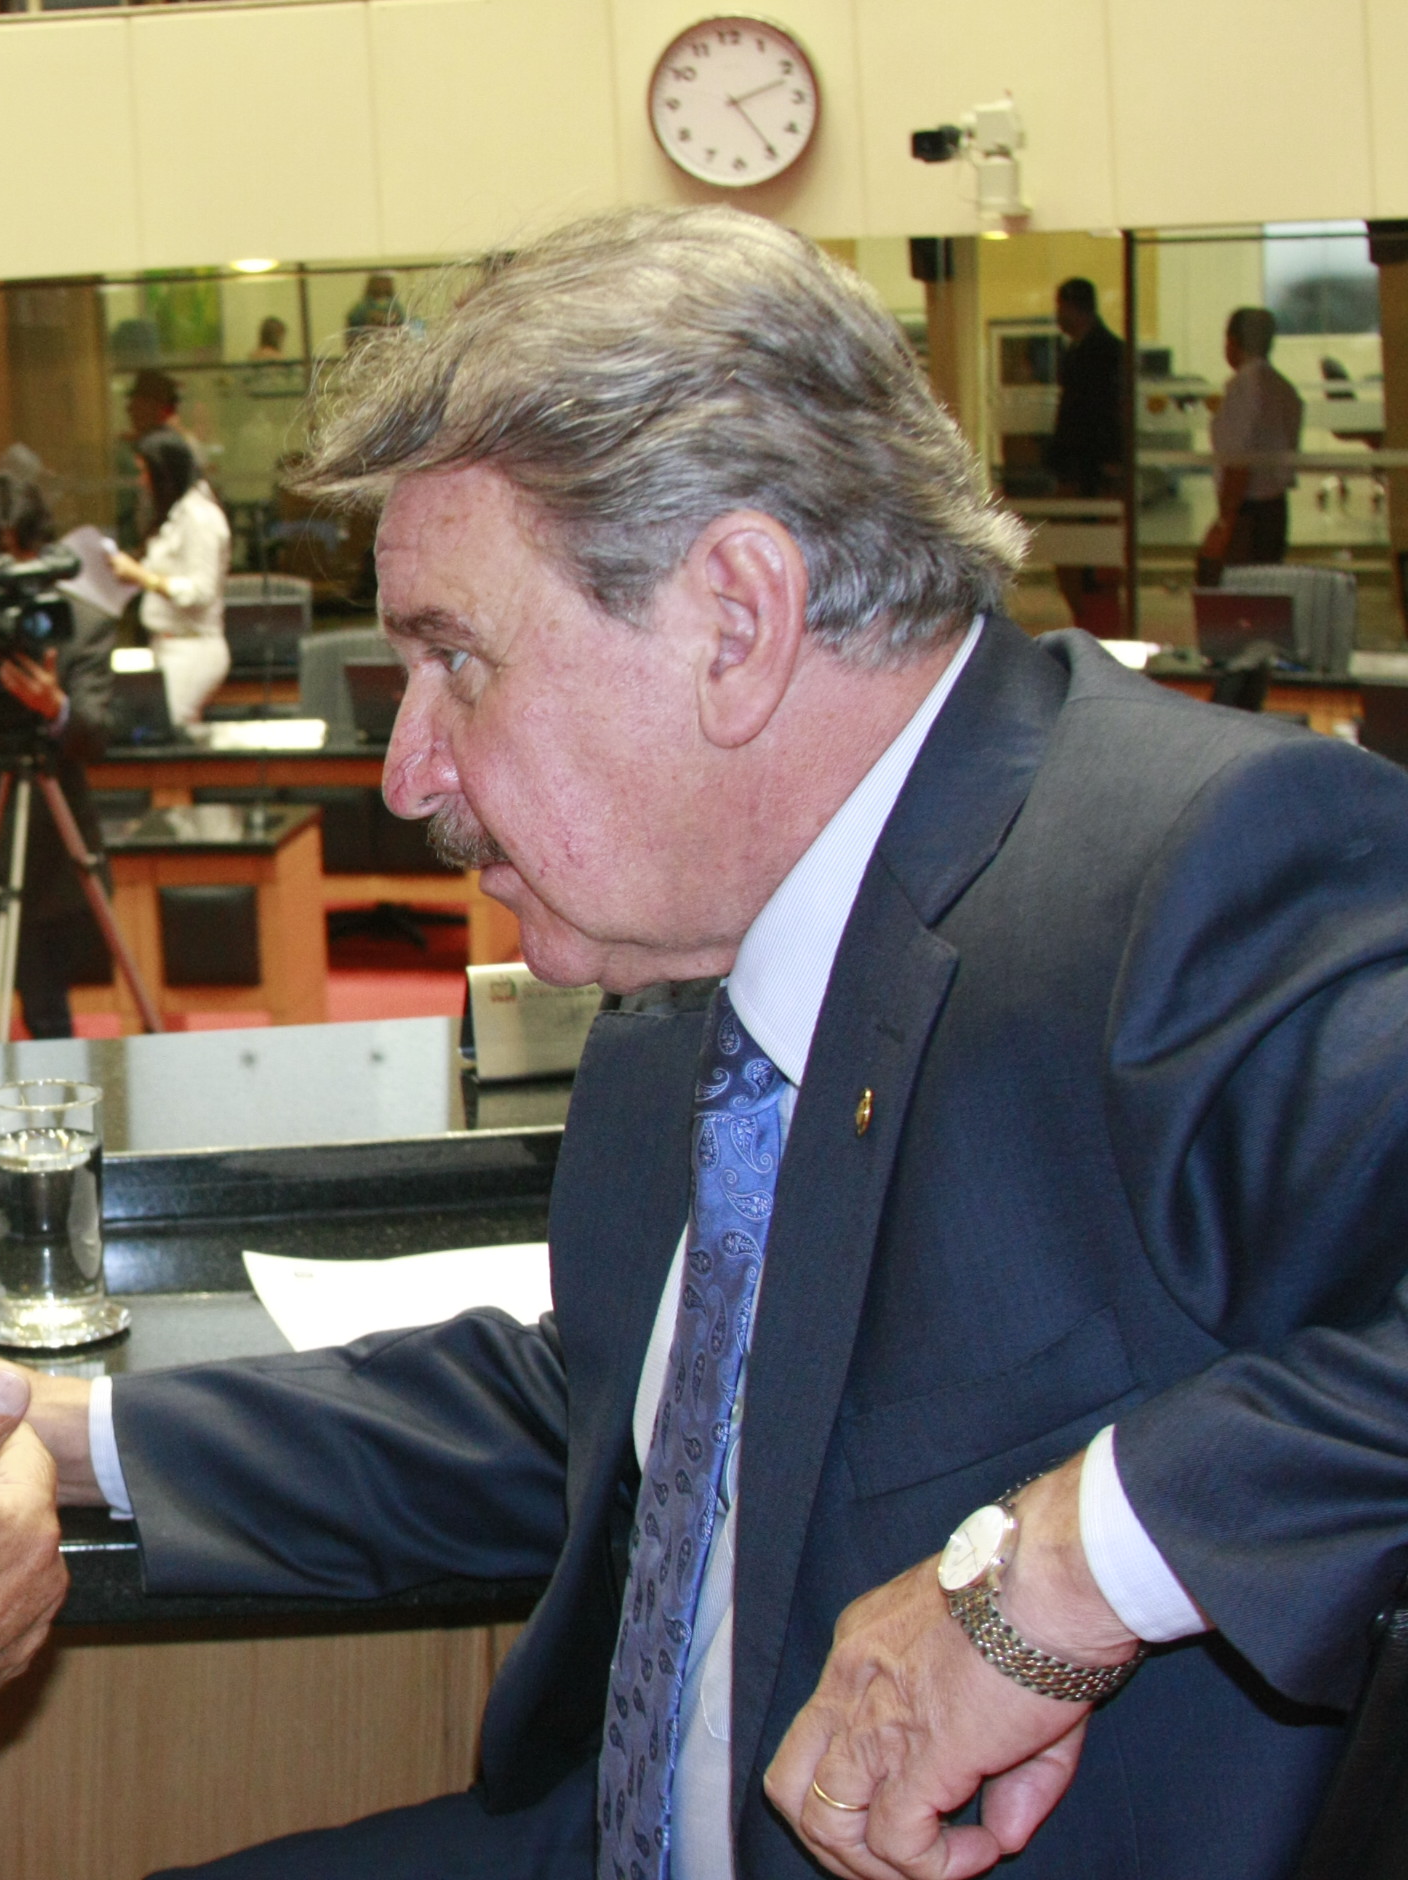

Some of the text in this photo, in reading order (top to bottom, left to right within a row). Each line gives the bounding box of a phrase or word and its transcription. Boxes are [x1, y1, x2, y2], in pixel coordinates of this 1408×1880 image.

[716, 29, 741, 45] 12
[692, 42, 710, 57] 11
[756, 38, 766, 52] 1
[669, 65, 697, 81] 10
[779, 59, 793, 75] 2
[666, 97, 680, 112] 9
[791, 89, 805, 105] 3
[678, 127, 691, 142] 8
[784, 121, 799, 134] 4
[706, 148, 717, 162] 7
[732, 157, 747, 171] 6
